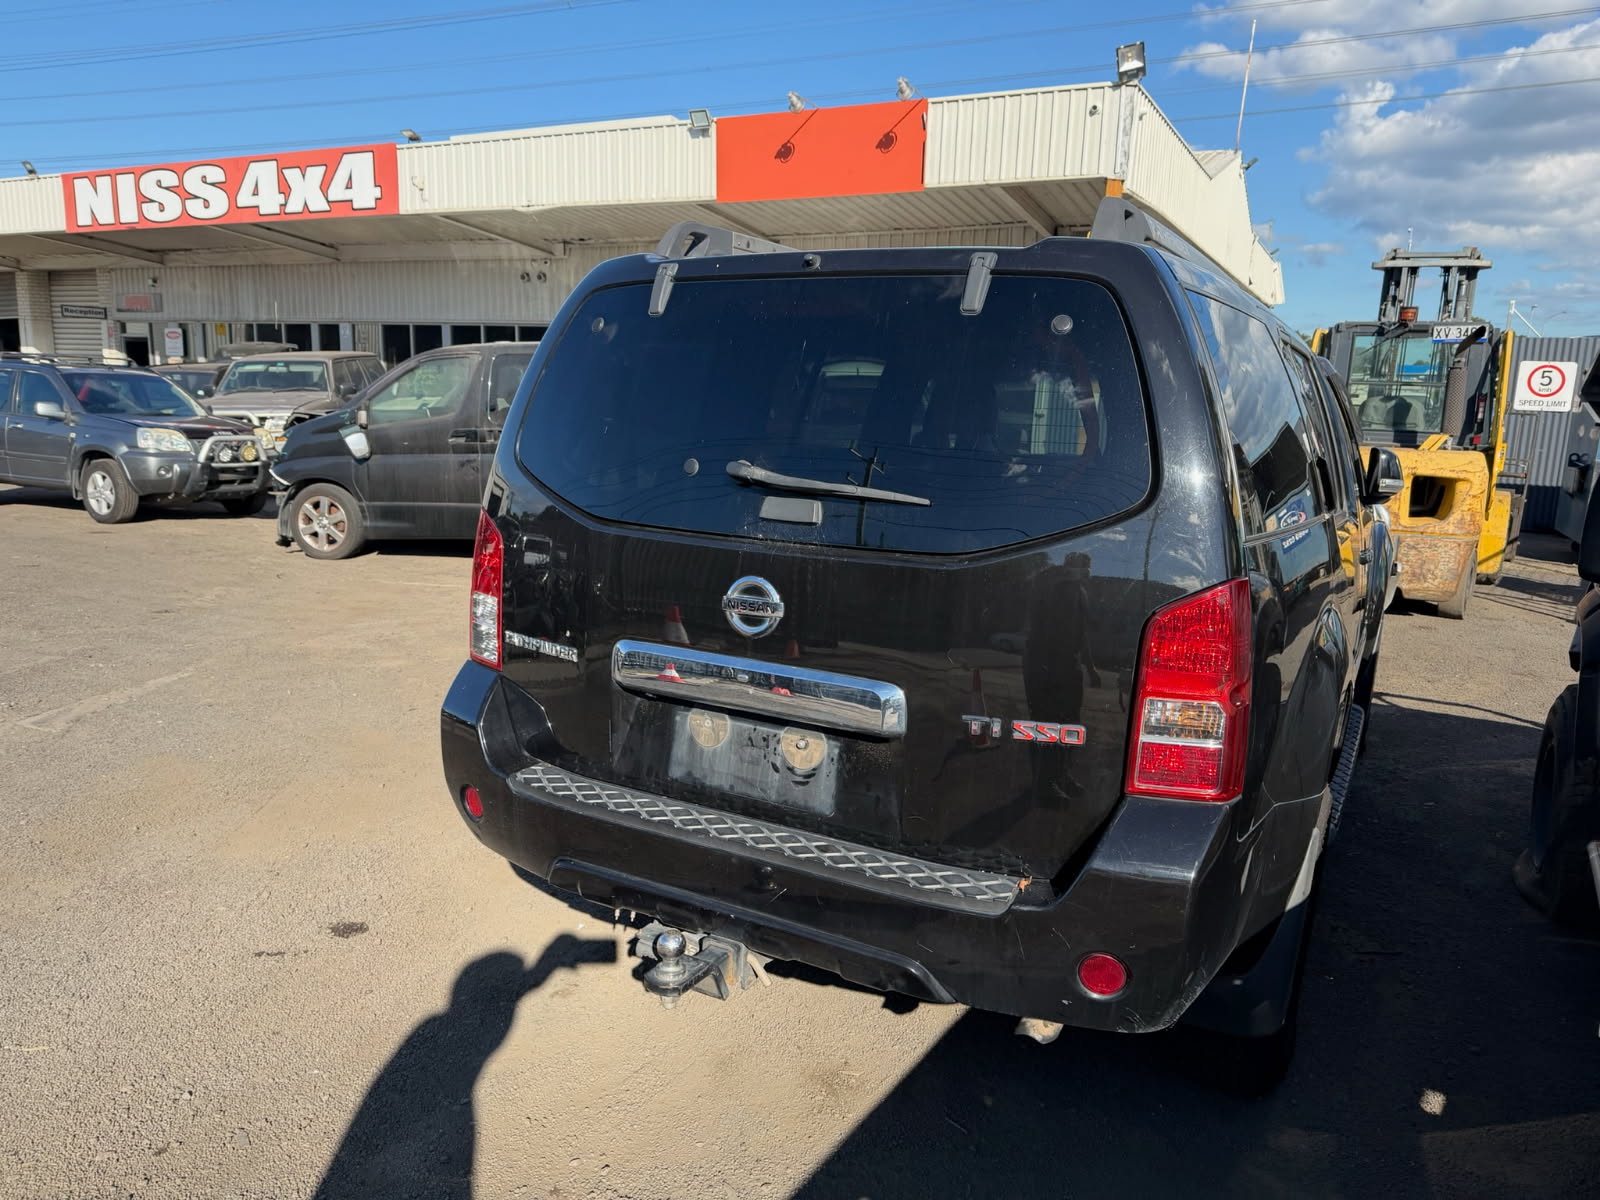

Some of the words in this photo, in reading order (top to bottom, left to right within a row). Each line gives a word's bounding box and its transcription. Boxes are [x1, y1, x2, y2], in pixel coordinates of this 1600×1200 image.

[73, 163, 230, 227] NISS
[236, 151, 383, 215] 4x4
[64, 307, 104, 316] Reception
[1435, 327, 1451, 339] XV
[1540, 370, 1553, 387] 5
[727, 600, 775, 614] NISSAN
